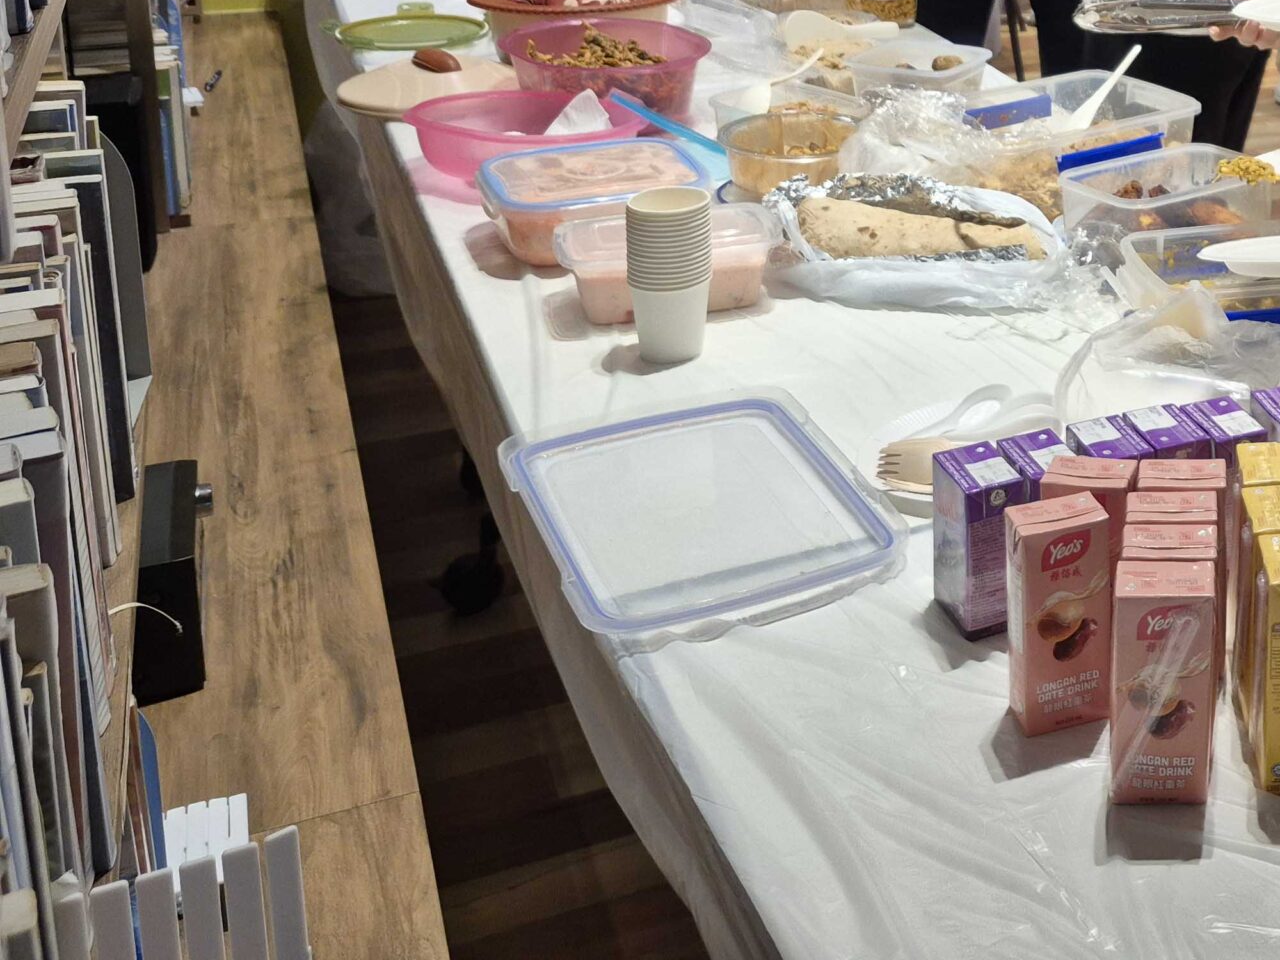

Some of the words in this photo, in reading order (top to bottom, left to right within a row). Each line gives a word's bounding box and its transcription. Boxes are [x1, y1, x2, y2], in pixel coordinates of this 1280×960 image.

[1049, 539, 1084, 565] Yeo's
[1146, 615, 1177, 636] Yeo
[1036, 674, 1077, 695] LONGAN
[1079, 669, 1100, 681] RED
[1038, 688, 1066, 704] DATE
[1067, 679, 1099, 695] DRINK
[1158, 766, 1194, 777] DRINK
[1172, 756, 1196, 767] RED
